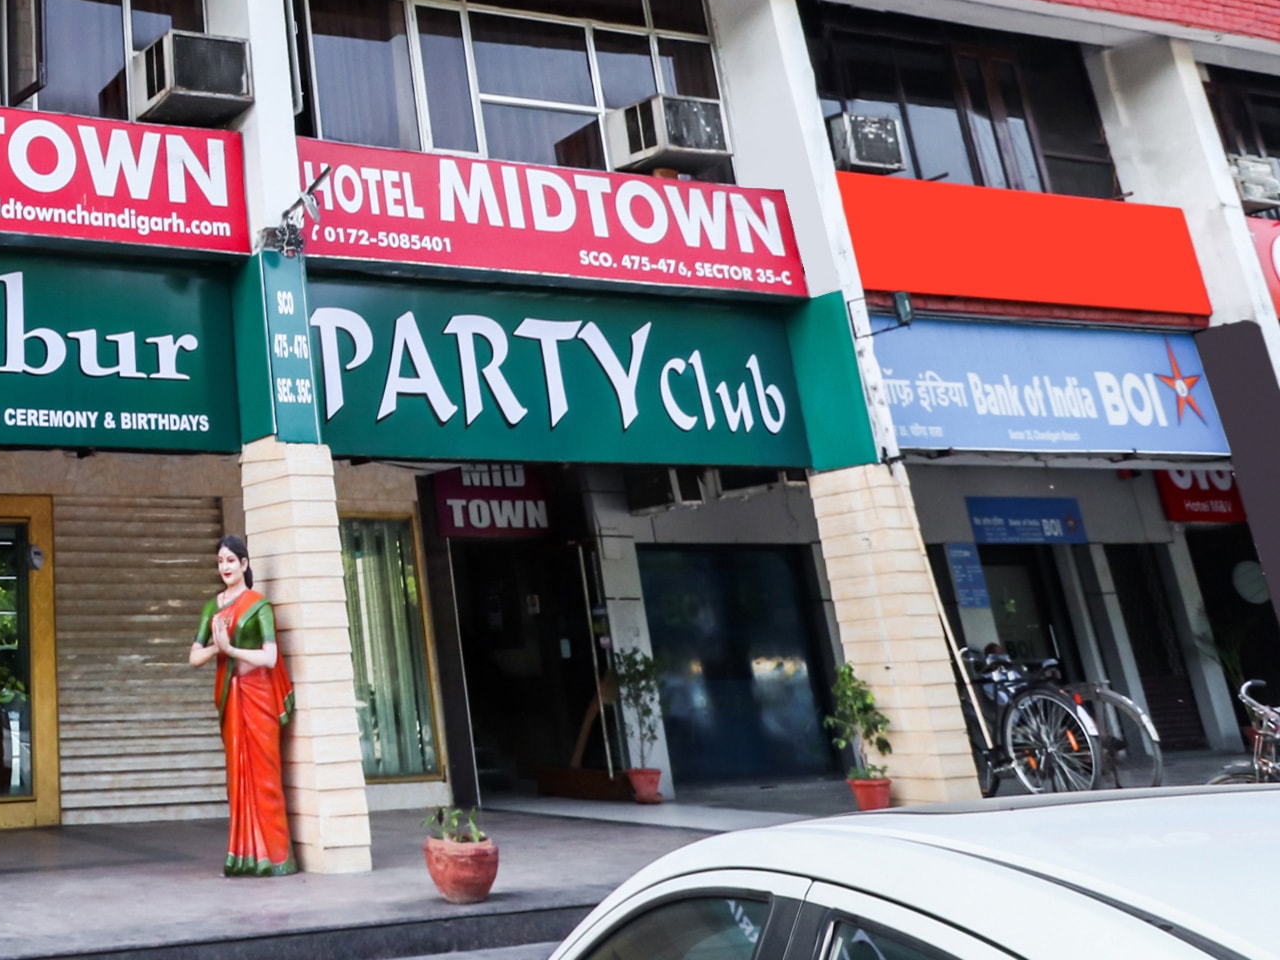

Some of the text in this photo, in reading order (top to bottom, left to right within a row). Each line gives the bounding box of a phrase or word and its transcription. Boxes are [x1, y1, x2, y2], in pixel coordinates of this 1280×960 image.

[303, 158, 786, 257] HOTEL MIDTOWN
[323, 225, 452, 253] 0172-5085401
[579, 249, 792, 286] SCO. 475-476, SECTOR 35-C
[277, 291, 294, 316] SCO
[274, 334, 308, 360] 475 476
[310, 306, 786, 435] PARTY Club
[276, 377, 312, 404] SEC. 35C
[915, 370, 969, 413] इंडिया
[966, 372, 1099, 419] Bank of India
[1093, 371, 1169, 428] BOI
[4, 408, 99, 429] CEREMONY
[104, 411, 116, 430] &
[120, 412, 210, 432] BIRTHDAYS
[461, 464, 525, 488] MID
[446, 498, 549, 529] TOWN
